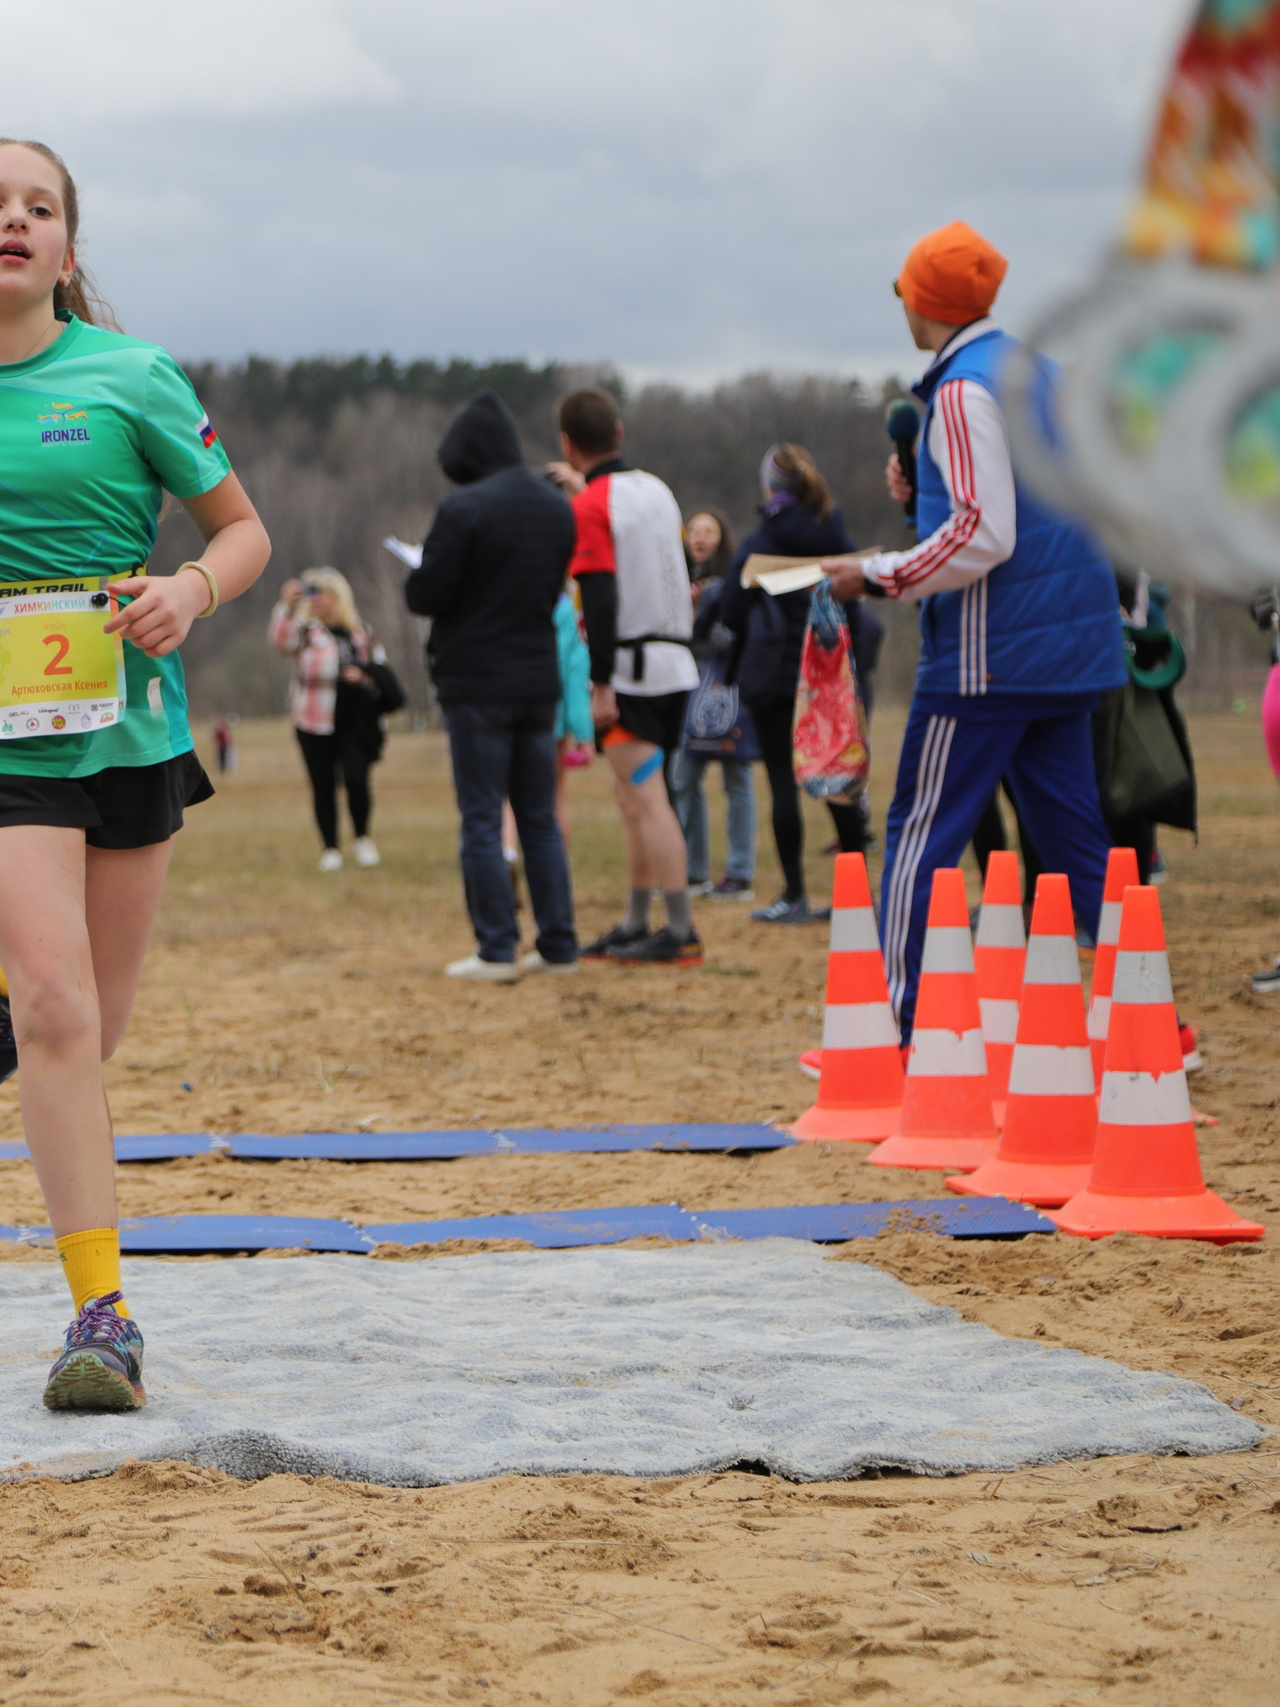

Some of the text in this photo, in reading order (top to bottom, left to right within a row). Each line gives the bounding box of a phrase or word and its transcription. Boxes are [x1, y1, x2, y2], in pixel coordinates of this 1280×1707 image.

[41, 428, 91, 442] IRONZEL
[33, 583, 90, 594] TRAIL
[14, 597, 86, 614] ХИМКИНСКИЙ
[42, 633, 73, 676] 2
[11, 680, 108, 697] Артюховская Ксения
